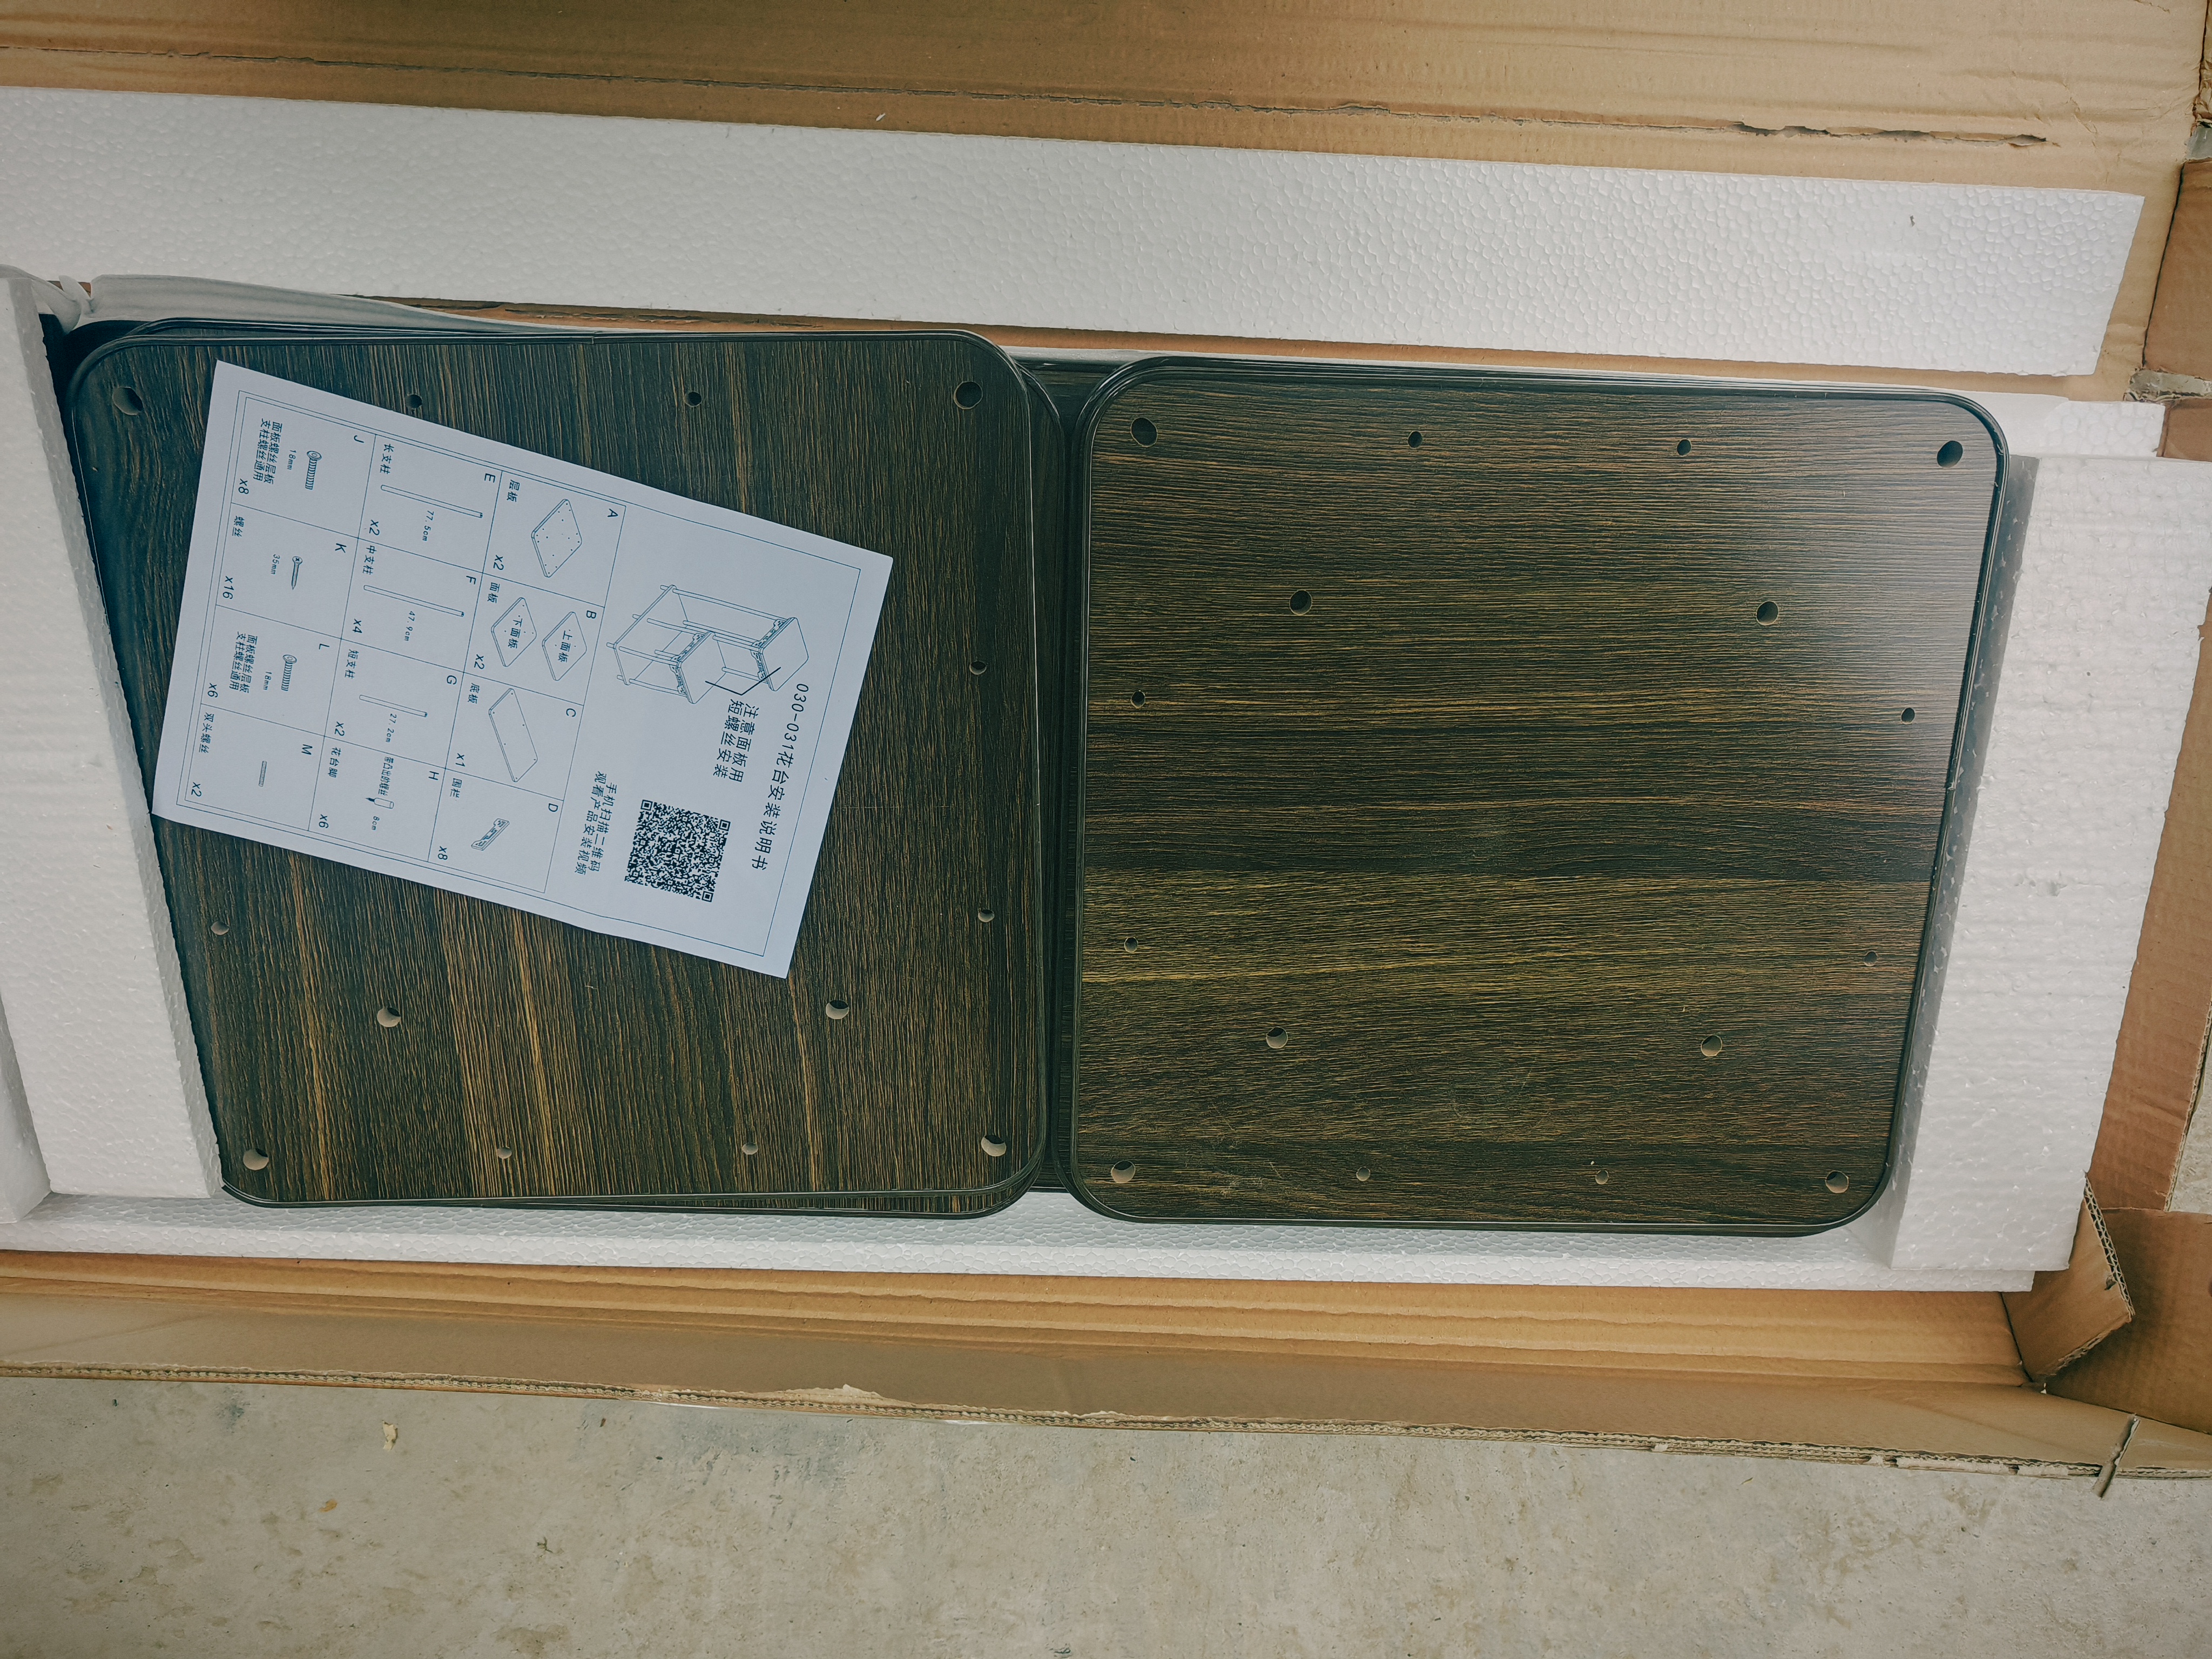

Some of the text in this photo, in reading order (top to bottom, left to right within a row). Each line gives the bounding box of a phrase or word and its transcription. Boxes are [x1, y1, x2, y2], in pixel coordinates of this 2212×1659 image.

[252, 417, 271, 481] 支柱螺丝通用
[353, 434, 365, 443] J
[262, 421, 283, 485] 面板螺丝层板
[286, 449, 297, 470] 18mm
[379, 443, 395, 475] 长支柱
[237, 477, 249, 495] x8
[483, 472, 496, 483] E
[505, 478, 520, 502] 层板
[606, 508, 618, 517] A
[231, 515, 245, 537] 螺丝
[368, 518, 380, 536] x2
[422, 510, 434, 541] 77.5cm
[334, 542, 347, 554] K
[270, 553, 280, 575] 35mm
[362, 544, 377, 575] 中支柱
[493, 554, 504, 570] x2
[222, 575, 234, 599] x16
[465, 575, 477, 585] F
[486, 581, 501, 604] 面板
[585, 609, 597, 619] B
[351, 618, 362, 633] x4
[403, 610, 415, 642] 47.9cm
[507, 617, 523, 649] 下面板
[557, 629, 573, 663] 上面板
[228, 630, 247, 690] 支柱螺丝通用
[238, 633, 258, 693] 面板螺丝层板
[343, 648, 359, 679] 短支柱
[473, 653, 485, 670] x2
[206, 682, 218, 698] x6
[262, 671, 272, 690] 18mm
[446, 674, 457, 685] G
[467, 682, 480, 704] 底板
[565, 707, 576, 717] C
[198, 711, 214, 753] 双头螺丝
[334, 720, 345, 737] x2
[385, 712, 397, 743] 27.2cm
[712, 698, 745, 779] 短螺丝安装
[727, 703, 759, 783] 注意面板用
[300, 743, 313, 756] M
[455, 752, 466, 767] x1
[327, 746, 342, 778] 花台脚
[377, 756, 394, 796] 带凸出的螺丝
[428, 770, 440, 781] H
[751, 683, 809, 871] 030-031花台安装说明书
[190, 781, 202, 797] x2
[449, 777, 462, 798] 围栏
[547, 802, 559, 812] D
[318, 813, 329, 829] x6
[370, 815, 380, 831] 8cm
[574, 770, 607, 875] 观看产品安装视频
[587, 781, 617, 872] 手机扫描二维码
[437, 845, 448, 860] x8
